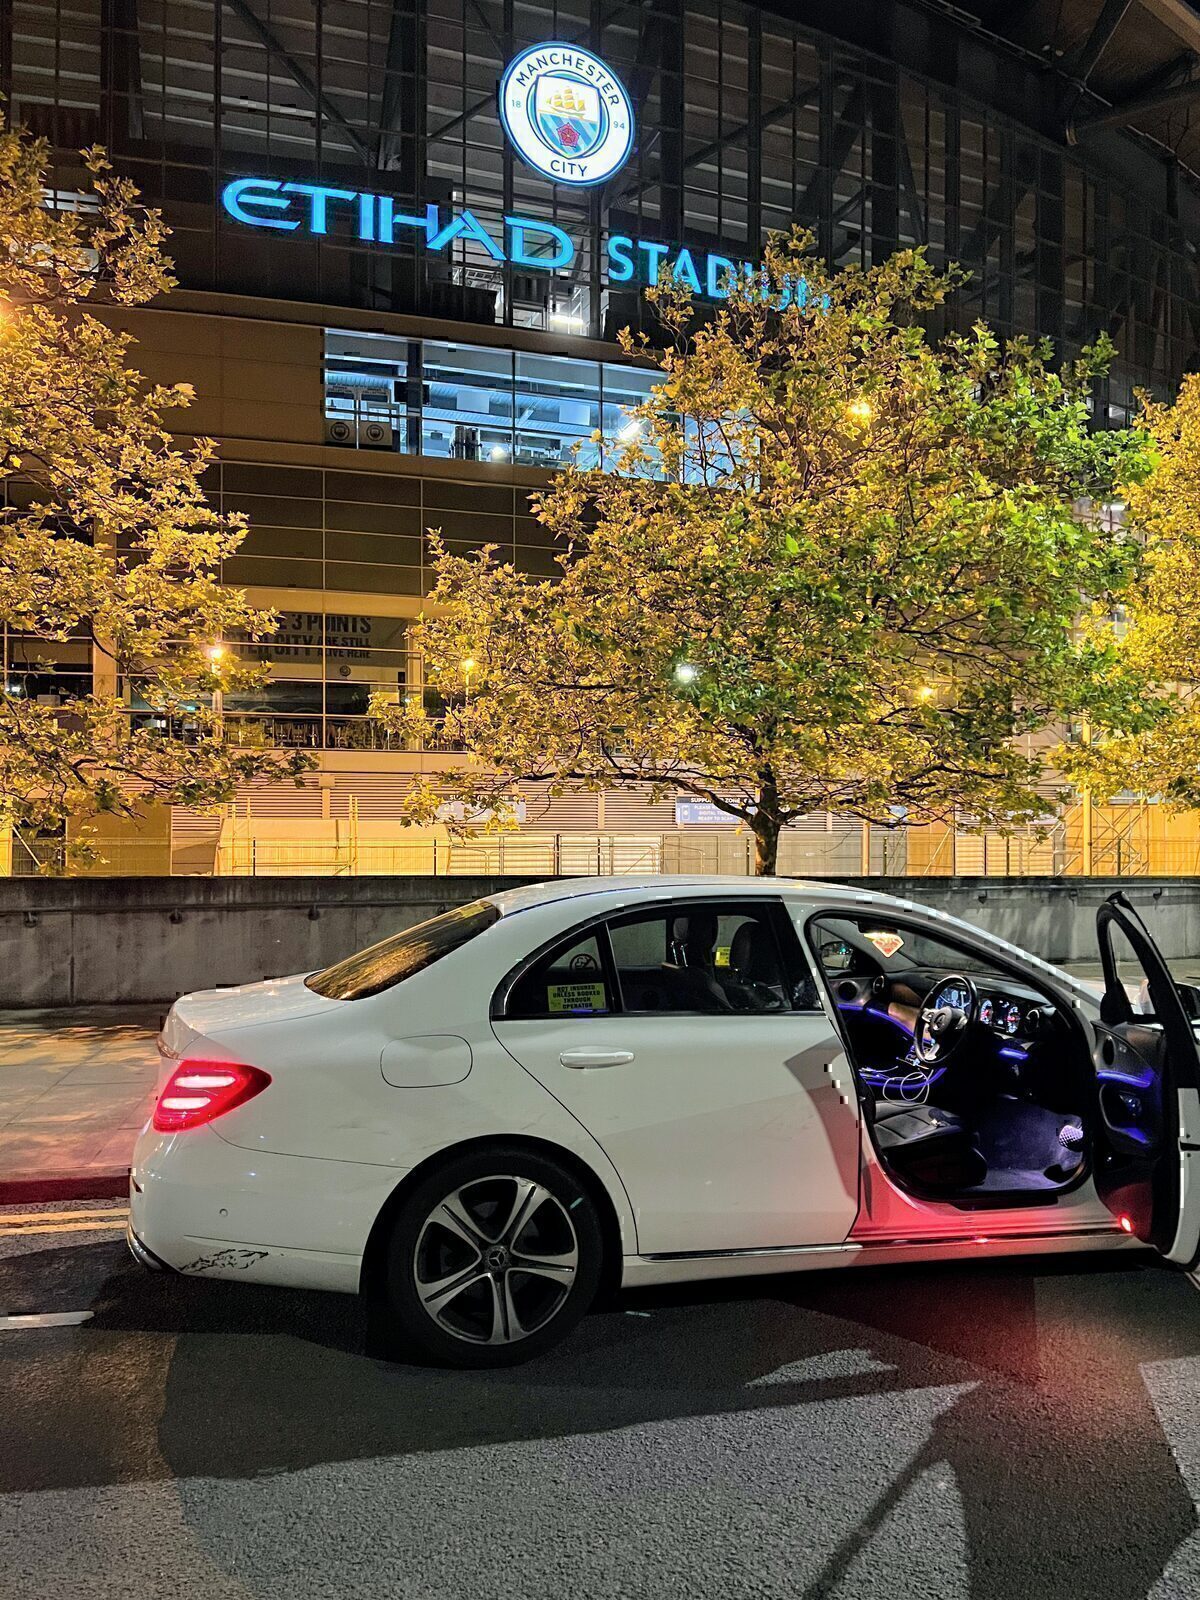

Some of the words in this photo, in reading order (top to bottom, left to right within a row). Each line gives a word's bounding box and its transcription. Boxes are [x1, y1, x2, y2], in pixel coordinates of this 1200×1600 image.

[515, 52, 620, 106] MANCHESTER
[511, 99, 521, 108] 18
[613, 120, 625, 130] 94
[550, 159, 588, 177] CITY
[222, 178, 575, 269] ETIHAD
[291, 613, 304, 631] 3
[306, 614, 372, 634] POINTS
[273, 633, 314, 657] CITY
[563, 996, 592, 1004] THROUGH
